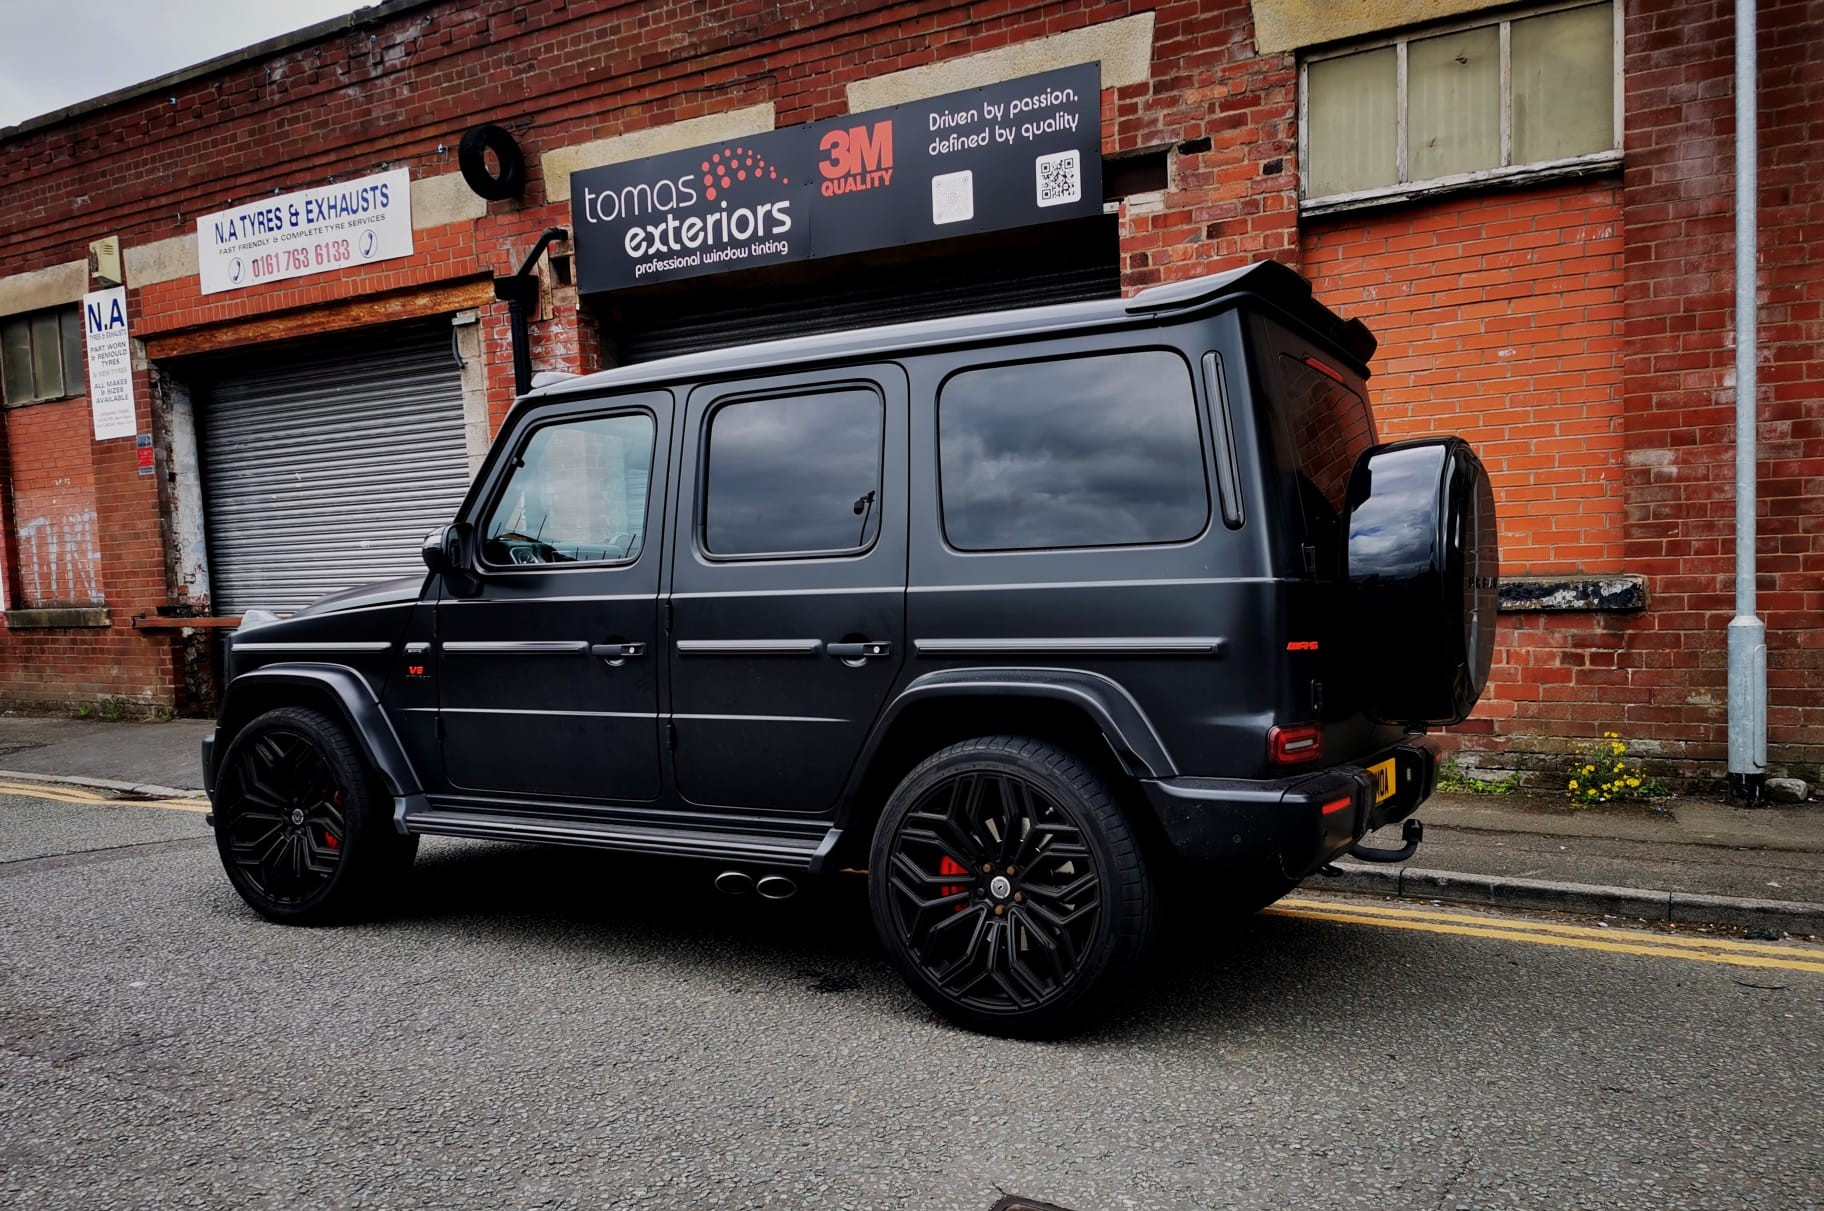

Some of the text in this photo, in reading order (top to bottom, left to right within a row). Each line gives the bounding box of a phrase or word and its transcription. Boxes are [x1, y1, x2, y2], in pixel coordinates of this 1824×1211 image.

[928, 111, 1079, 156] defined by quality
[929, 108, 978, 131] Driven
[983, 102, 1004, 121] by
[818, 119, 894, 179] 3M
[584, 174, 697, 223] tomas
[821, 169, 894, 197] QUALITY
[214, 183, 390, 245] N.A TYRES & EXHAUSTS
[624, 200, 792, 258] exteriors
[219, 213, 386, 256] FAST FRIENDLY & COMPLETE TYRE SERVICES
[251, 239, 350, 278] 0161 763 6133
[635, 240, 788, 278] professional window tinting
[87, 298, 125, 333] N.A
[90, 341, 127, 353] PART WORN
[97, 349, 128, 359] REMOULD
[101, 359, 121, 367] TYRES
[96, 394, 129, 404] AVAILABLE
[106, 379, 128, 387] MAKES
